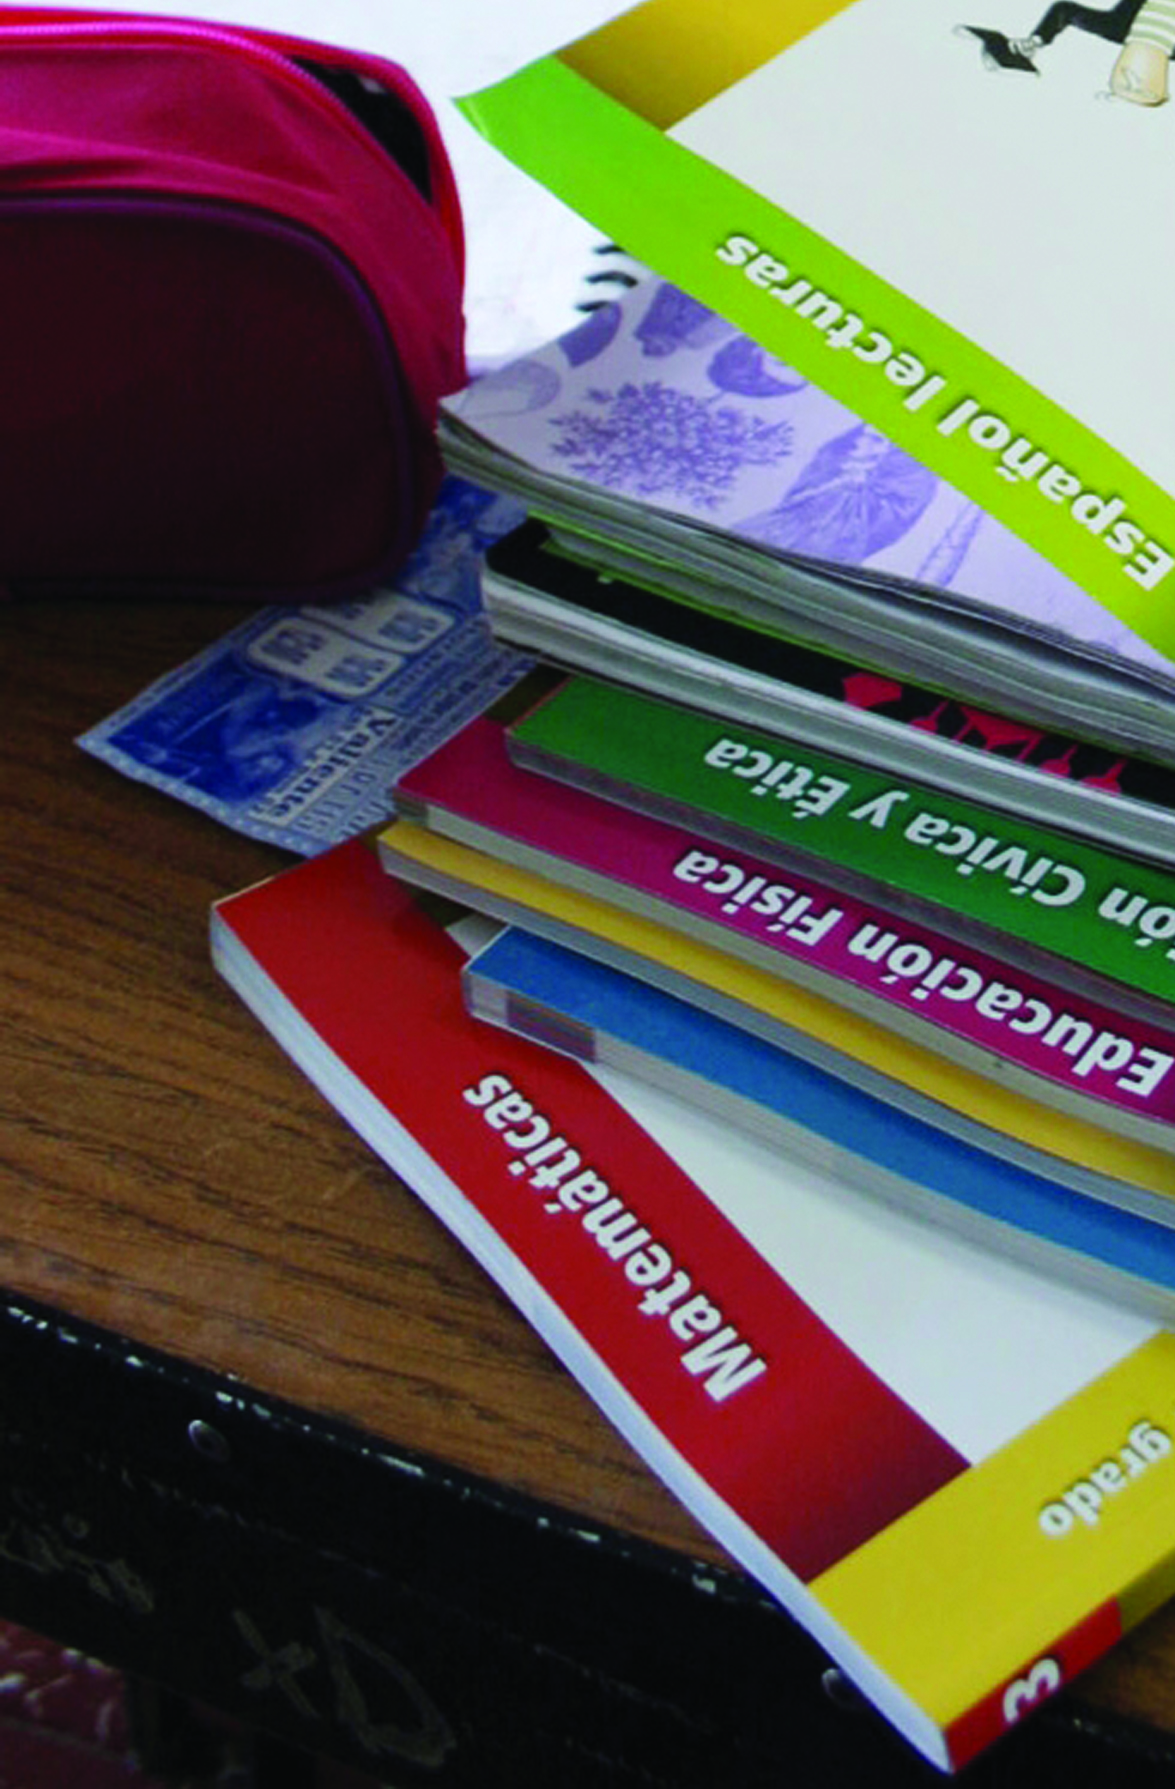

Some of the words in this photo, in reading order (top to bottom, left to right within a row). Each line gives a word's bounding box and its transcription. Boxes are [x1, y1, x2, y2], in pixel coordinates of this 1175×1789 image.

[715, 233, 947, 412] lecturas
[270, 717, 397, 818] Valiente
[704, 738, 852, 819] Ética
[848, 790, 910, 829] y
[672, 848, 844, 948] Física
[904, 812, 1087, 907] Cívica
[847, 923, 1175, 1099] Educación
[461, 1073, 768, 1404] Matemáticas
[1039, 1418, 1173, 1539] grado
[1003, 1657, 1060, 1723] 3
